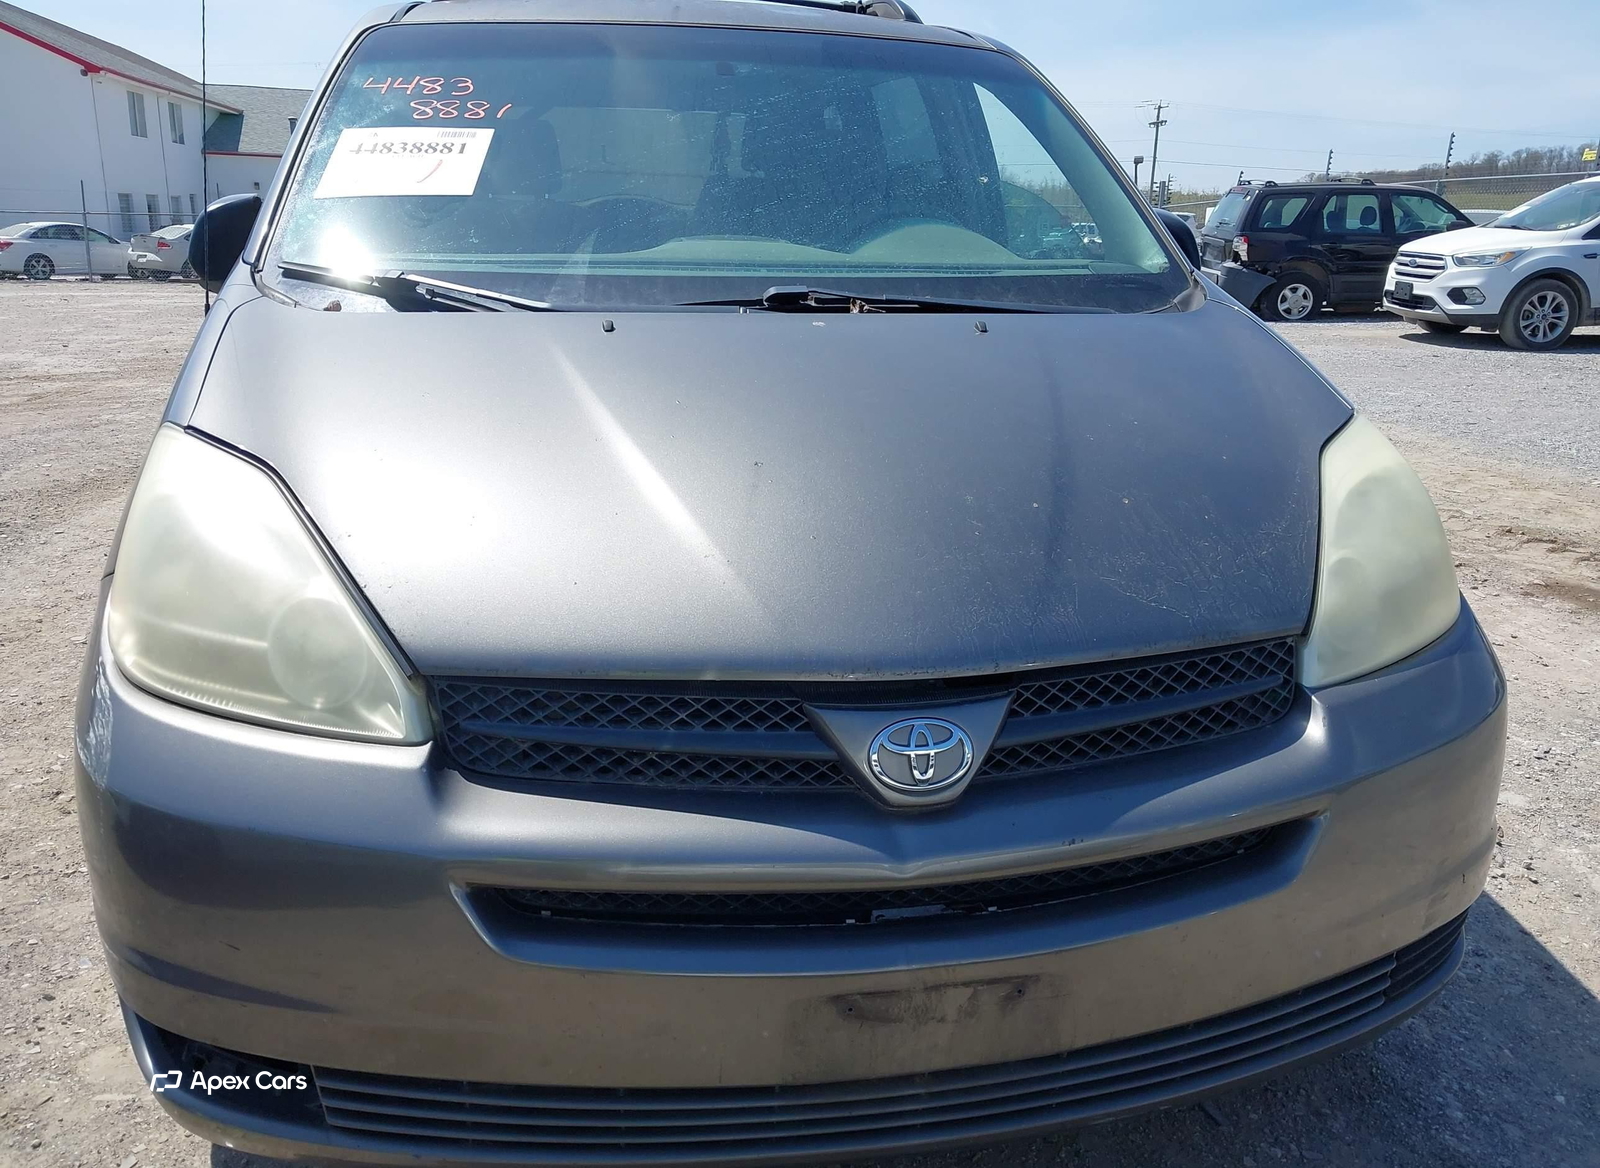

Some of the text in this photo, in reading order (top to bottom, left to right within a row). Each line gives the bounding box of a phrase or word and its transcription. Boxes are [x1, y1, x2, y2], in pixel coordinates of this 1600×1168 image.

[363, 76, 474, 95] 4483
[409, 99, 512, 119] 8881
[349, 141, 468, 155] 44838881
